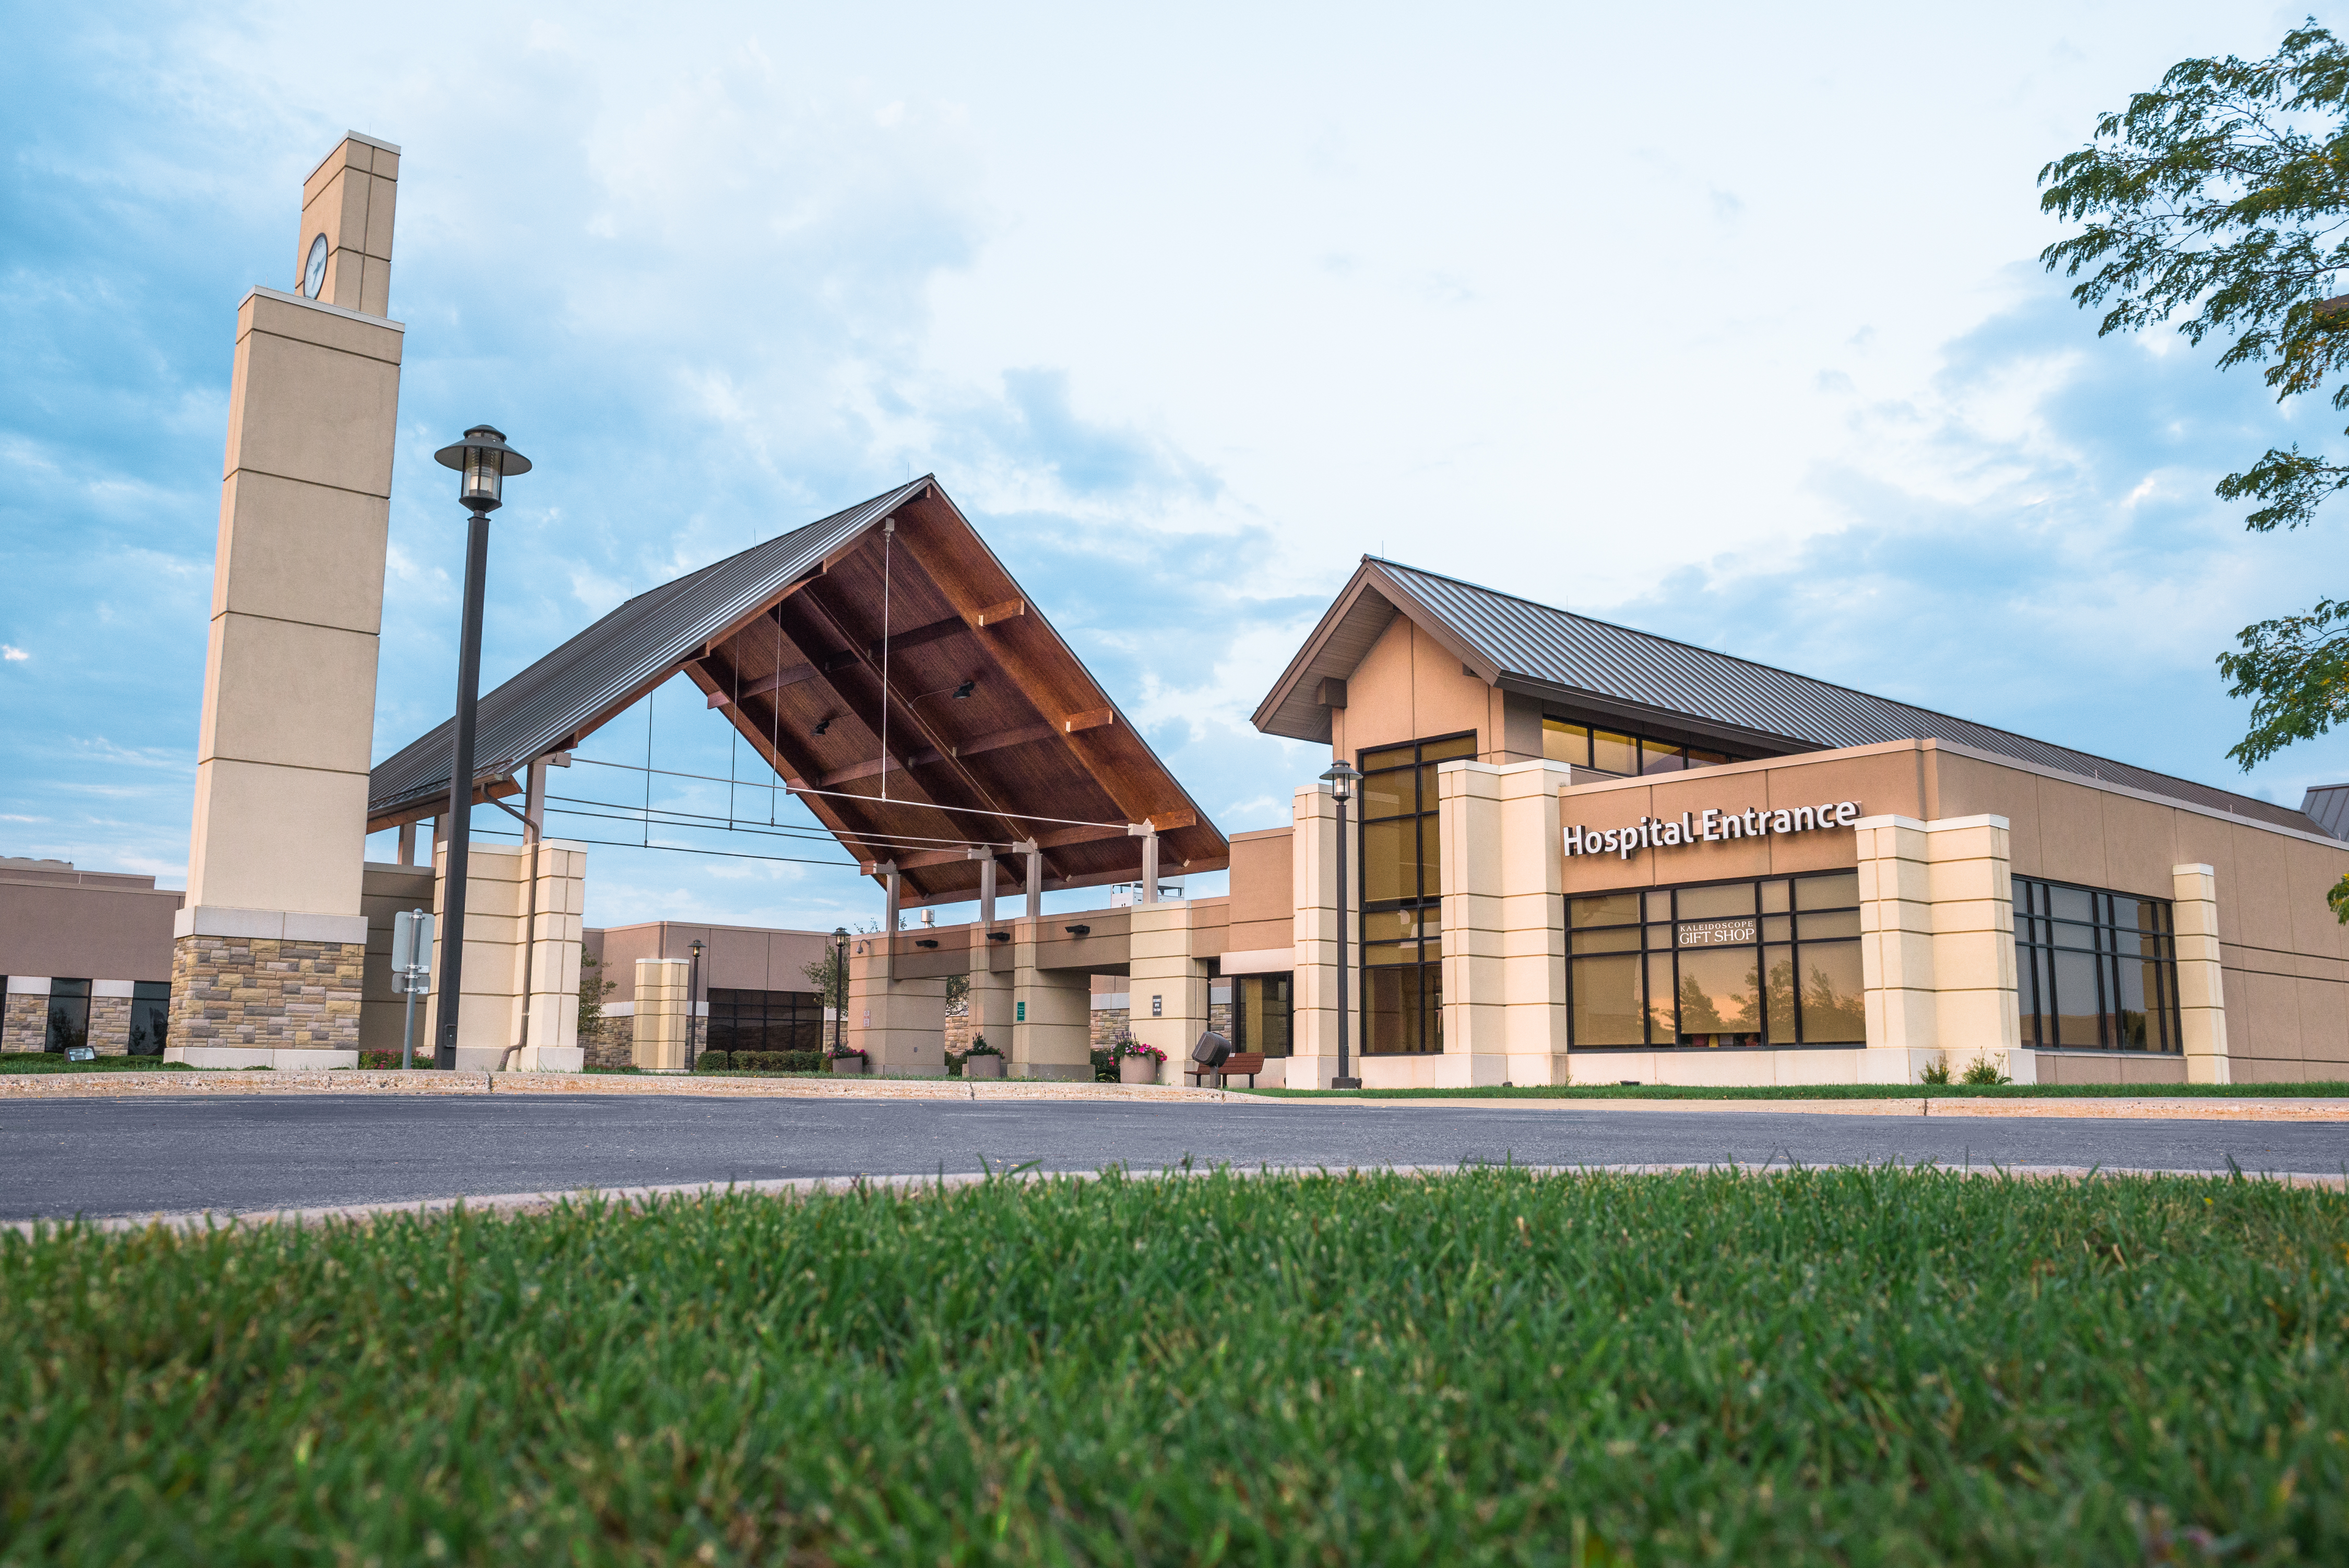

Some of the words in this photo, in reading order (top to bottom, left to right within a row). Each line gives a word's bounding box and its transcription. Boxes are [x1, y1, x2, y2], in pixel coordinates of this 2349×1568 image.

[1563, 811, 1694, 860] Hospital
[1702, 801, 1858, 841] Entrance
[1680, 921, 1753, 932] KALEIDOSCOPE
[1680, 931, 1711, 944] GIFT
[1714, 929, 1754, 942] SHOP
